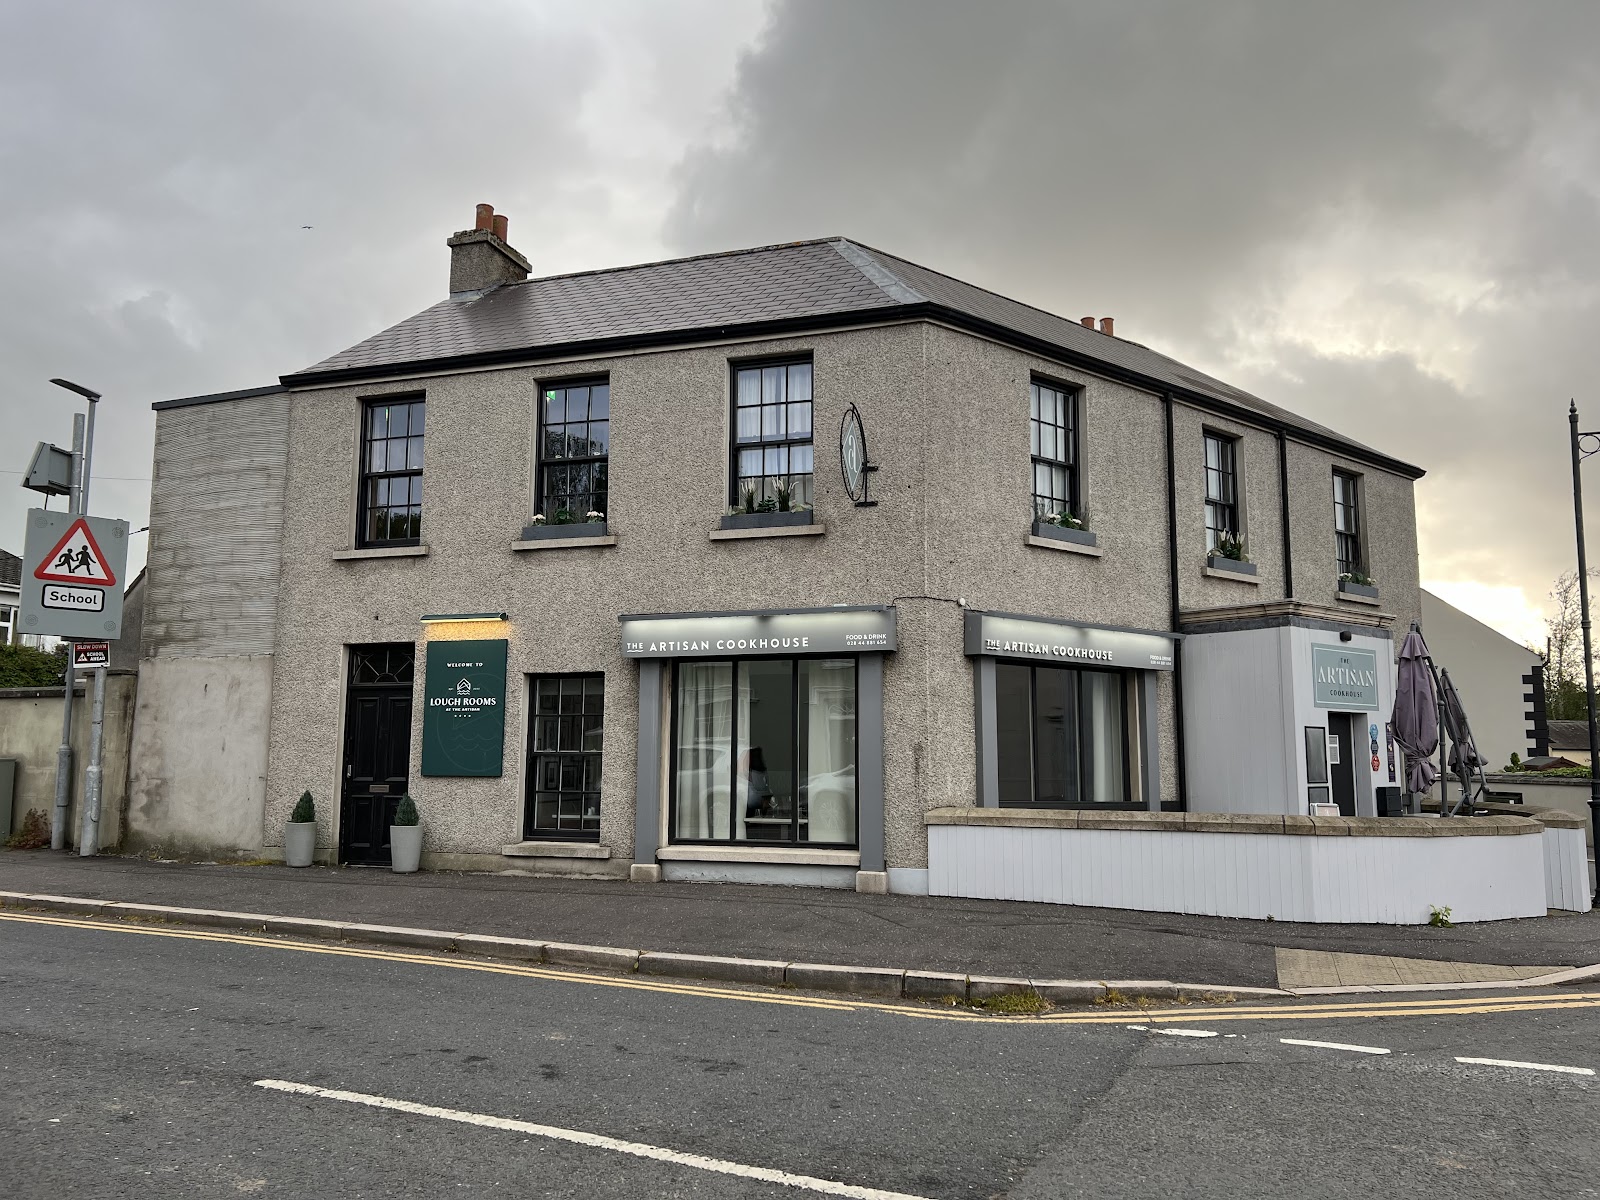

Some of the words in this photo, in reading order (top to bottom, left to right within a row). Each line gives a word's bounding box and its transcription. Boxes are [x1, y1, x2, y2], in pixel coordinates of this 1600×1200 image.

[50, 591, 98, 605] School
[649, 640, 709, 652] ARTISAN
[716, 637, 809, 650] COOKHOUSE
[986, 639, 1000, 647] THE
[1003, 641, 1049, 655] ARTISAN
[1052, 645, 1113, 661] COOKHOUSE
[1318, 666, 1374, 687] ARTISAN
[1330, 689, 1363, 698] COOKHOUSE
[430, 697, 461, 706] LOUGH
[463, 697, 497, 706] ROOMS
